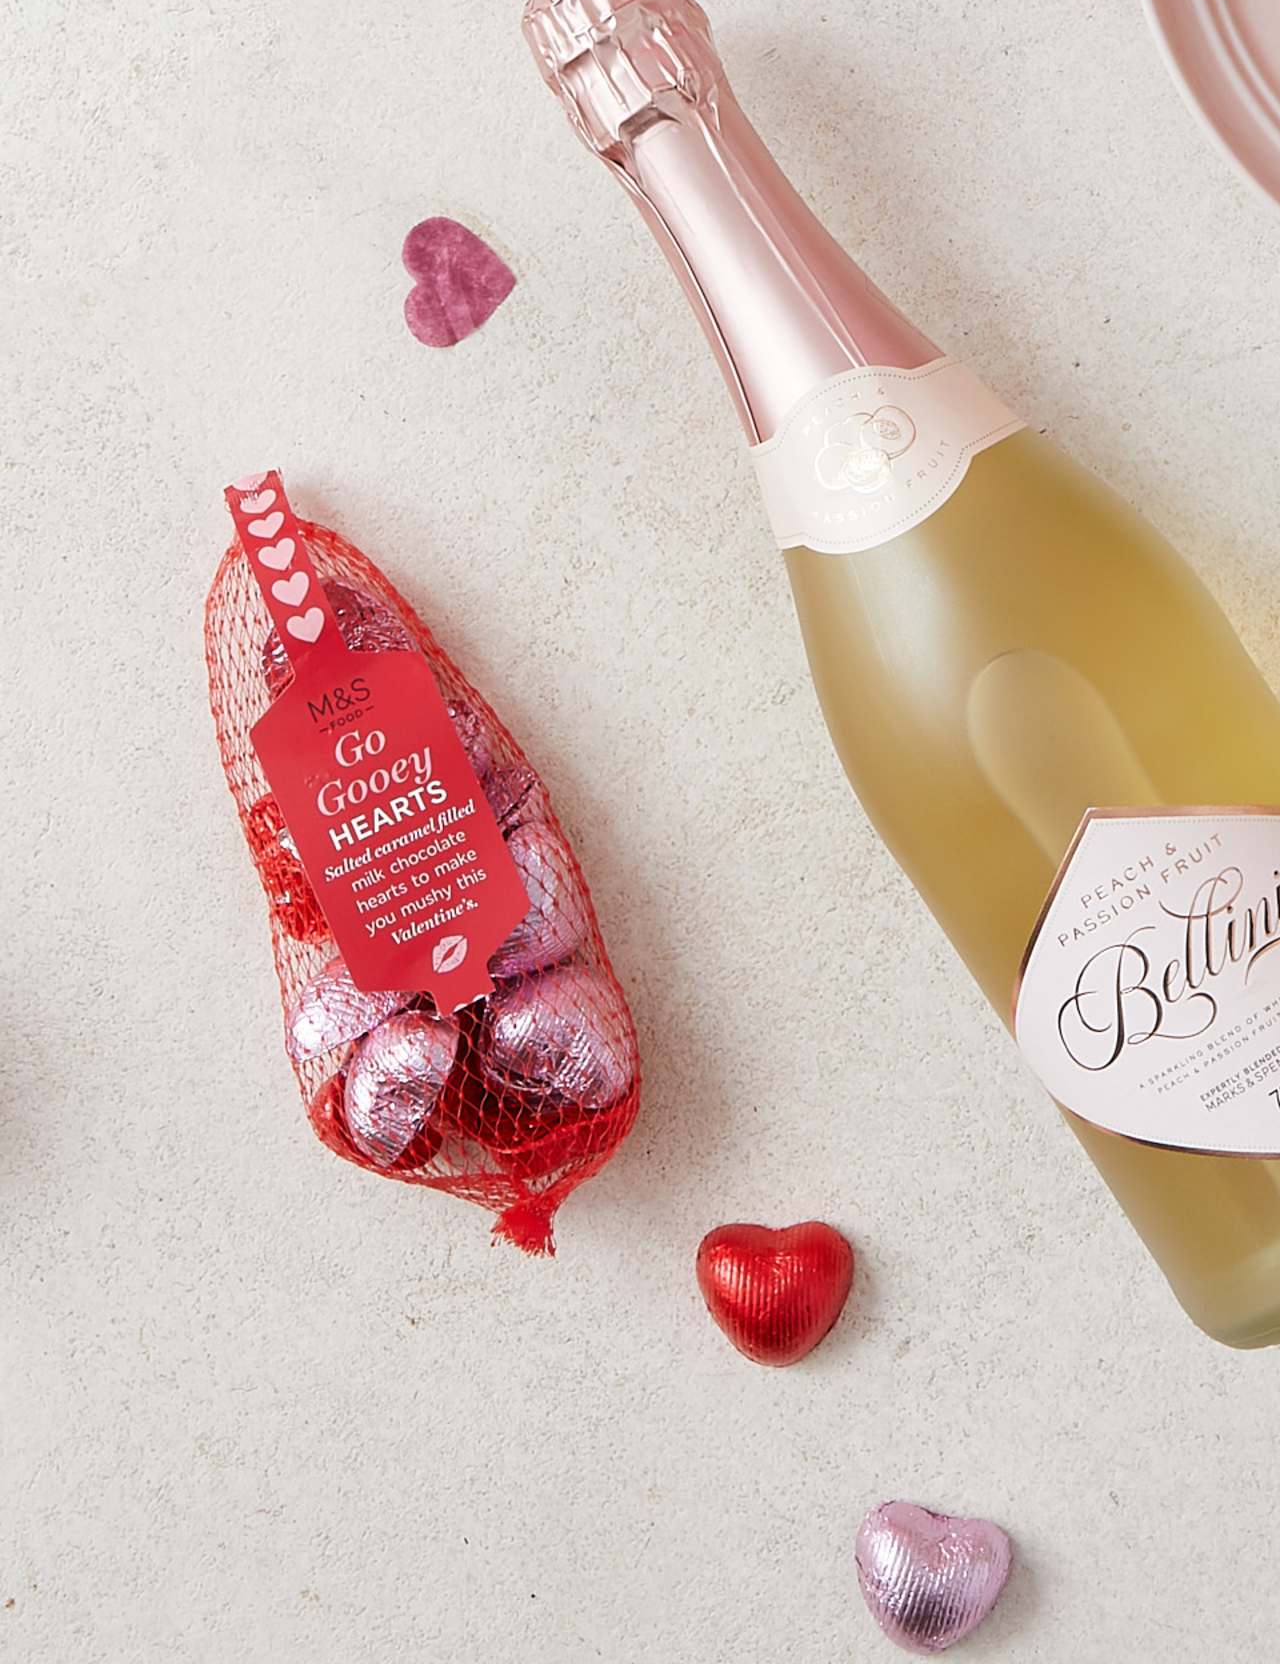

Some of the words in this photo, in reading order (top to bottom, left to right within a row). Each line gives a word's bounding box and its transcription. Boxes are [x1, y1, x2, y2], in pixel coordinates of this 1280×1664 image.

[905, 439, 952, 489] FRUIT
[306, 678, 372, 724] M&S
[335, 729, 387, 768] Go
[316, 746, 433, 817] Gooey
[323, 847, 372, 882] Salted
[374, 816, 437, 860] caramel
[435, 798, 477, 834] filled
[328, 780, 448, 852] HEARTS
[351, 867, 387, 894] milk
[389, 830, 467, 874] chocolate
[356, 882, 409, 915] hearts
[411, 871, 431, 888] to
[434, 849, 478, 878] make
[1057, 883, 1152, 948] PASSION
[1159, 832, 1225, 884] FRUIT
[1080, 855, 1156, 910] PEACH
[1165, 841, 1178, 856] &
[365, 911, 398, 938] you
[400, 884, 453, 918] mushy
[456, 868, 488, 890] this
[391, 897, 480, 945] Valentine's.
[1147, 1048, 1205, 1086] SPARKLING
[1206, 1024, 1243, 1051] BLEND
[1245, 1012, 1259, 1026] OF
[1156, 1072, 1190, 1094] PEACH
[1193, 1067, 1200, 1076] &
[1203, 1035, 1250, 1068] PASSION
[1200, 1072, 1242, 1103] EXPERTLY
[1205, 1083, 1247, 1113] MARKS
[1246, 1075, 1256, 1088] &
